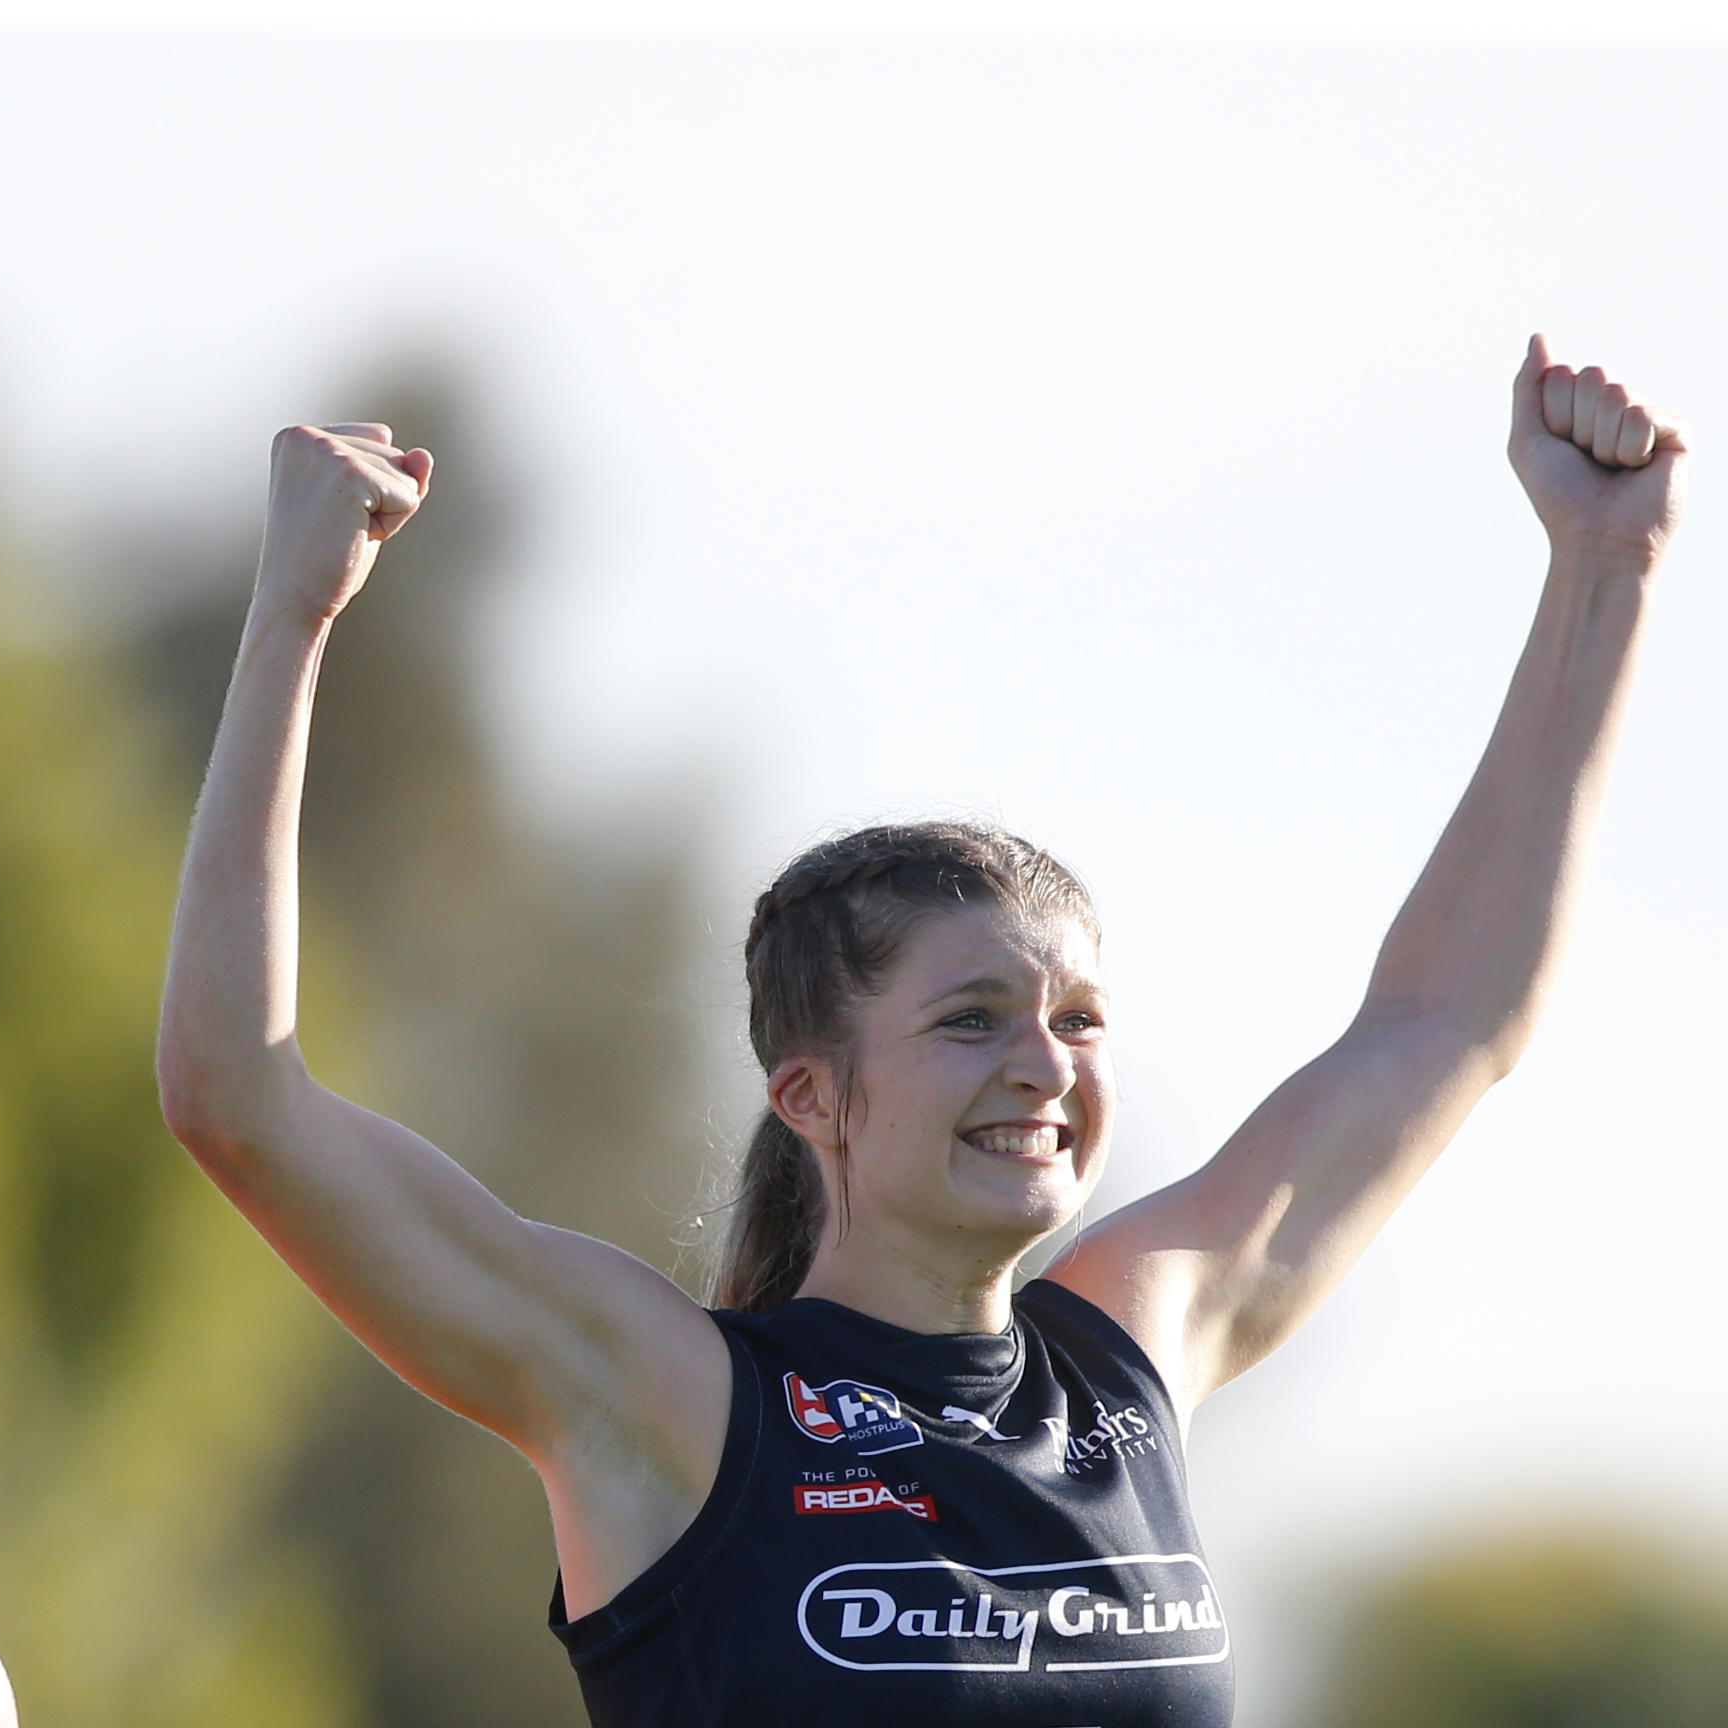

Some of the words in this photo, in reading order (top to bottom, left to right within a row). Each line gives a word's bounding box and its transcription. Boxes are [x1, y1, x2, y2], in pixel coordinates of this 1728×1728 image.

[848, 1422, 906, 1441] HOSTPLUS
[802, 1471, 835, 1482] THE
[898, 1482, 920, 1495] OF
[823, 1588, 1039, 1670] Daily
[1048, 1585, 1221, 1638] Grind
